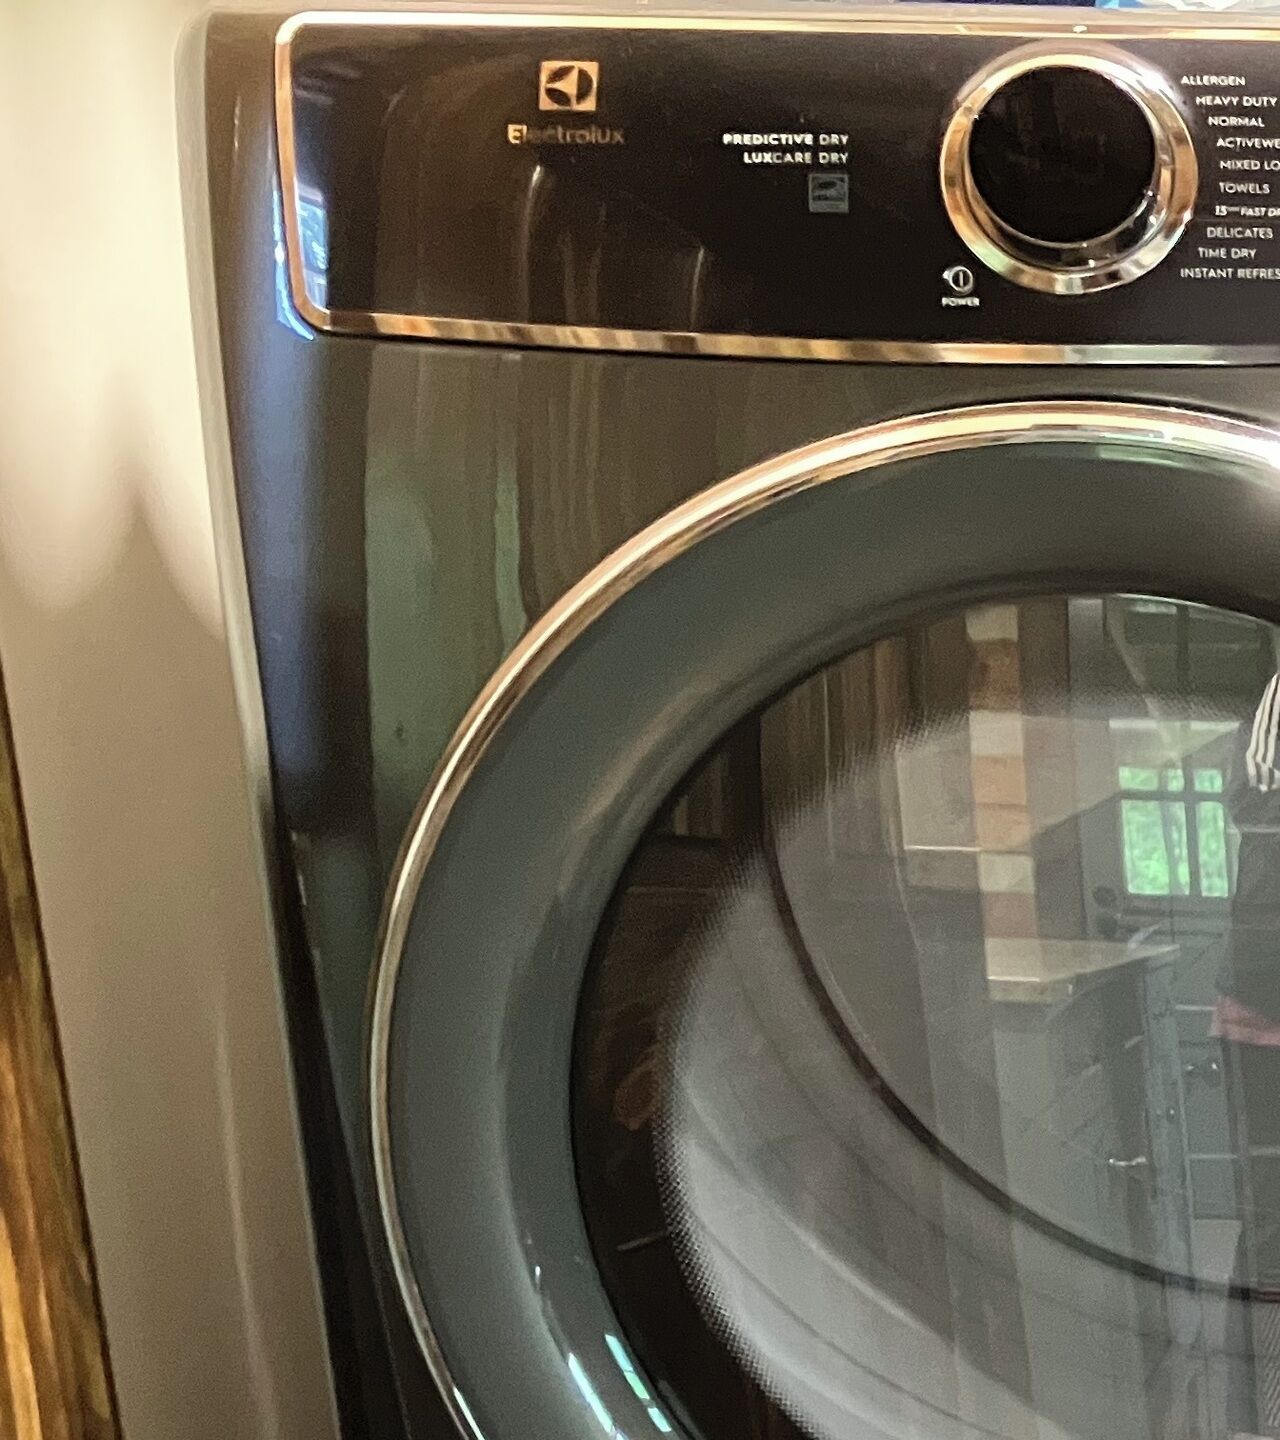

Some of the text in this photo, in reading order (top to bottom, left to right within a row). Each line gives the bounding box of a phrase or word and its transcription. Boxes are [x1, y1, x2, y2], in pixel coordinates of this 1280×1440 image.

[1181, 75, 1246, 87] ALLERGEN
[1196, 95, 1278, 108] HEAVY DUTY
[1208, 116, 1265, 128] NORMAL
[722, 132, 849, 146] PREDICTIVE DRY
[743, 152, 849, 165] LUXCARE DRY
[1220, 160, 1260, 171] MIXED
[1219, 182, 1270, 194] TOWELS
[1240, 207, 1266, 216] FAST
[1206, 226, 1274, 240] DELICATES
[1198, 247, 1256, 260] TIME DRY
[1180, 267, 1234, 279] INSTANT
[942, 297, 980, 307] POWER
